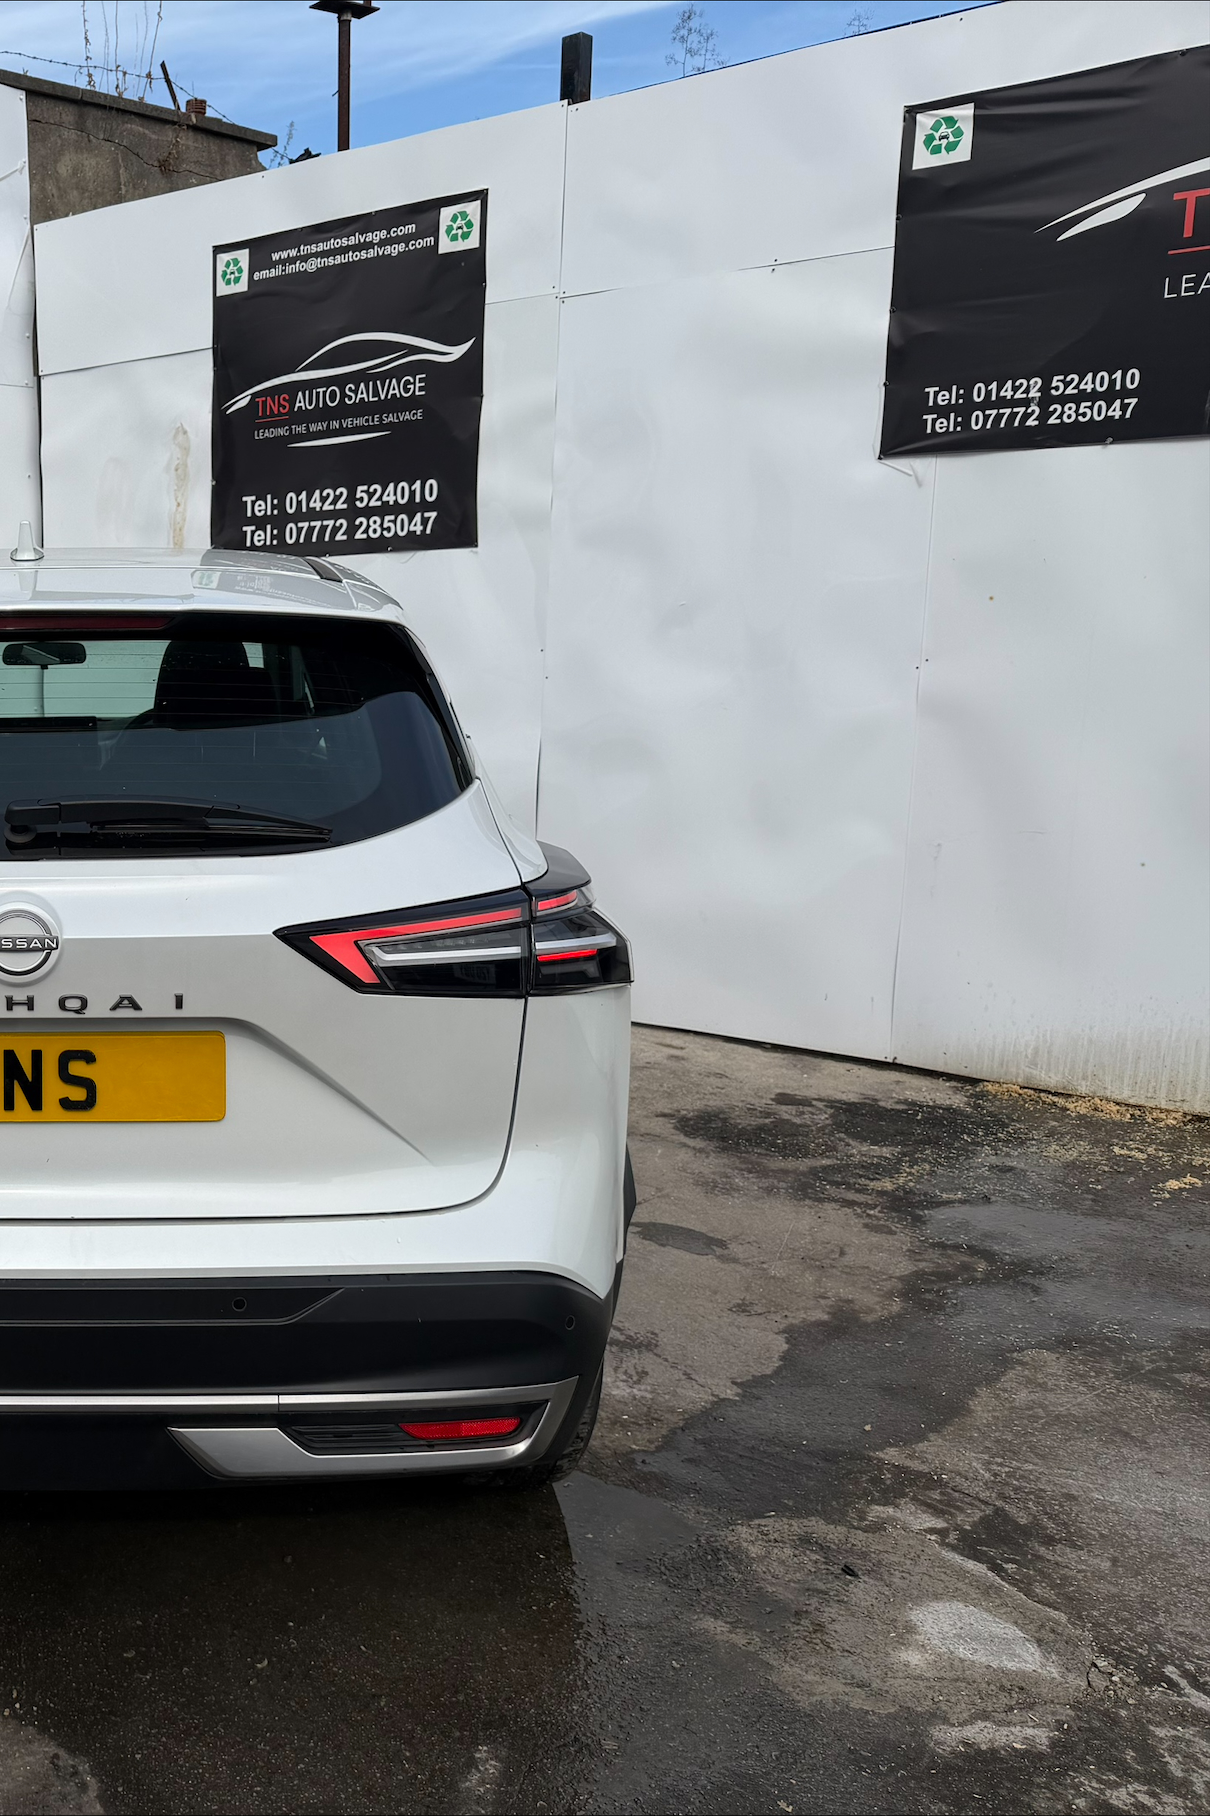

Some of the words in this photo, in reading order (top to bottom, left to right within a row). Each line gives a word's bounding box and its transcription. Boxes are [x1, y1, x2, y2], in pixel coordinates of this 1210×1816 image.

[253, 236, 434, 281] email:info@tnsautosalvage.com
[271, 223, 416, 261] www.tnsautosalvage.com
[256, 394, 290, 416] TNS
[294, 386, 340, 412] AUTO
[344, 374, 426, 405] SALVAGE
[925, 386, 965, 407] Tel:
[972, 377, 1042, 402] 01422
[1050, 368, 1141, 396] 524010
[254, 426, 289, 440] LEADING
[291, 423, 306, 434] THE
[309, 421, 327, 432] WAY
[330, 419, 339, 430] IN
[341, 414, 380, 428] VEHICLE
[382, 409, 423, 424] SALVAGE
[922, 413, 963, 434] Tel:
[970, 406, 1040, 430] 07772
[1047, 397, 1139, 425] 285047
[242, 494, 278, 517] Tel:
[285, 487, 348, 515] 01422
[355, 479, 438, 509] 524010
[242, 524, 278, 547] Tel:
[285, 519, 348, 544] 07772
[354, 512, 437, 540] 285047
